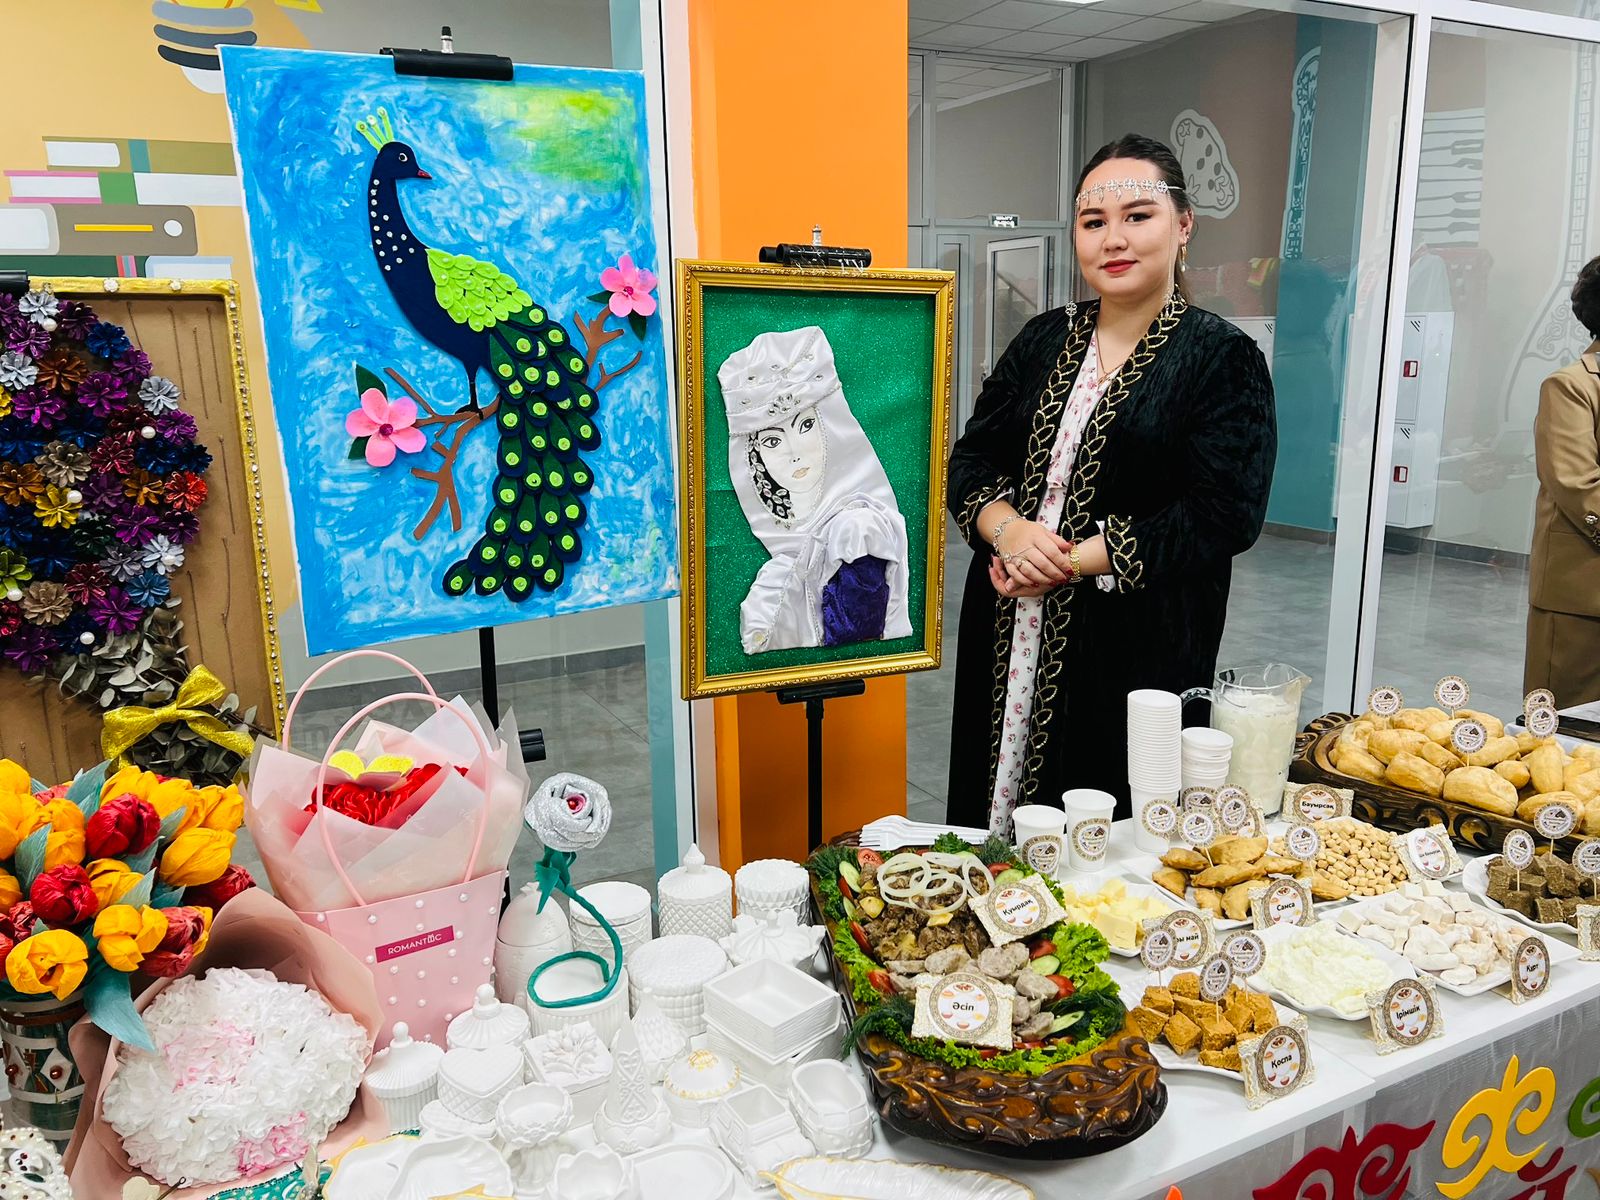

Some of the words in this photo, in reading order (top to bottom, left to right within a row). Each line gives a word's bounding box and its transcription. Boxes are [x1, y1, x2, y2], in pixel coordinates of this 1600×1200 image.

[1302, 801, 1335, 811] Бауырсақ
[1276, 902, 1295, 911] Самса
[1186, 932, 1199, 942] май
[387, 933, 442, 955] ROMANTIC
[952, 1002, 974, 1012] Әсіп
[1396, 1004, 1421, 1020] Ірімшік
